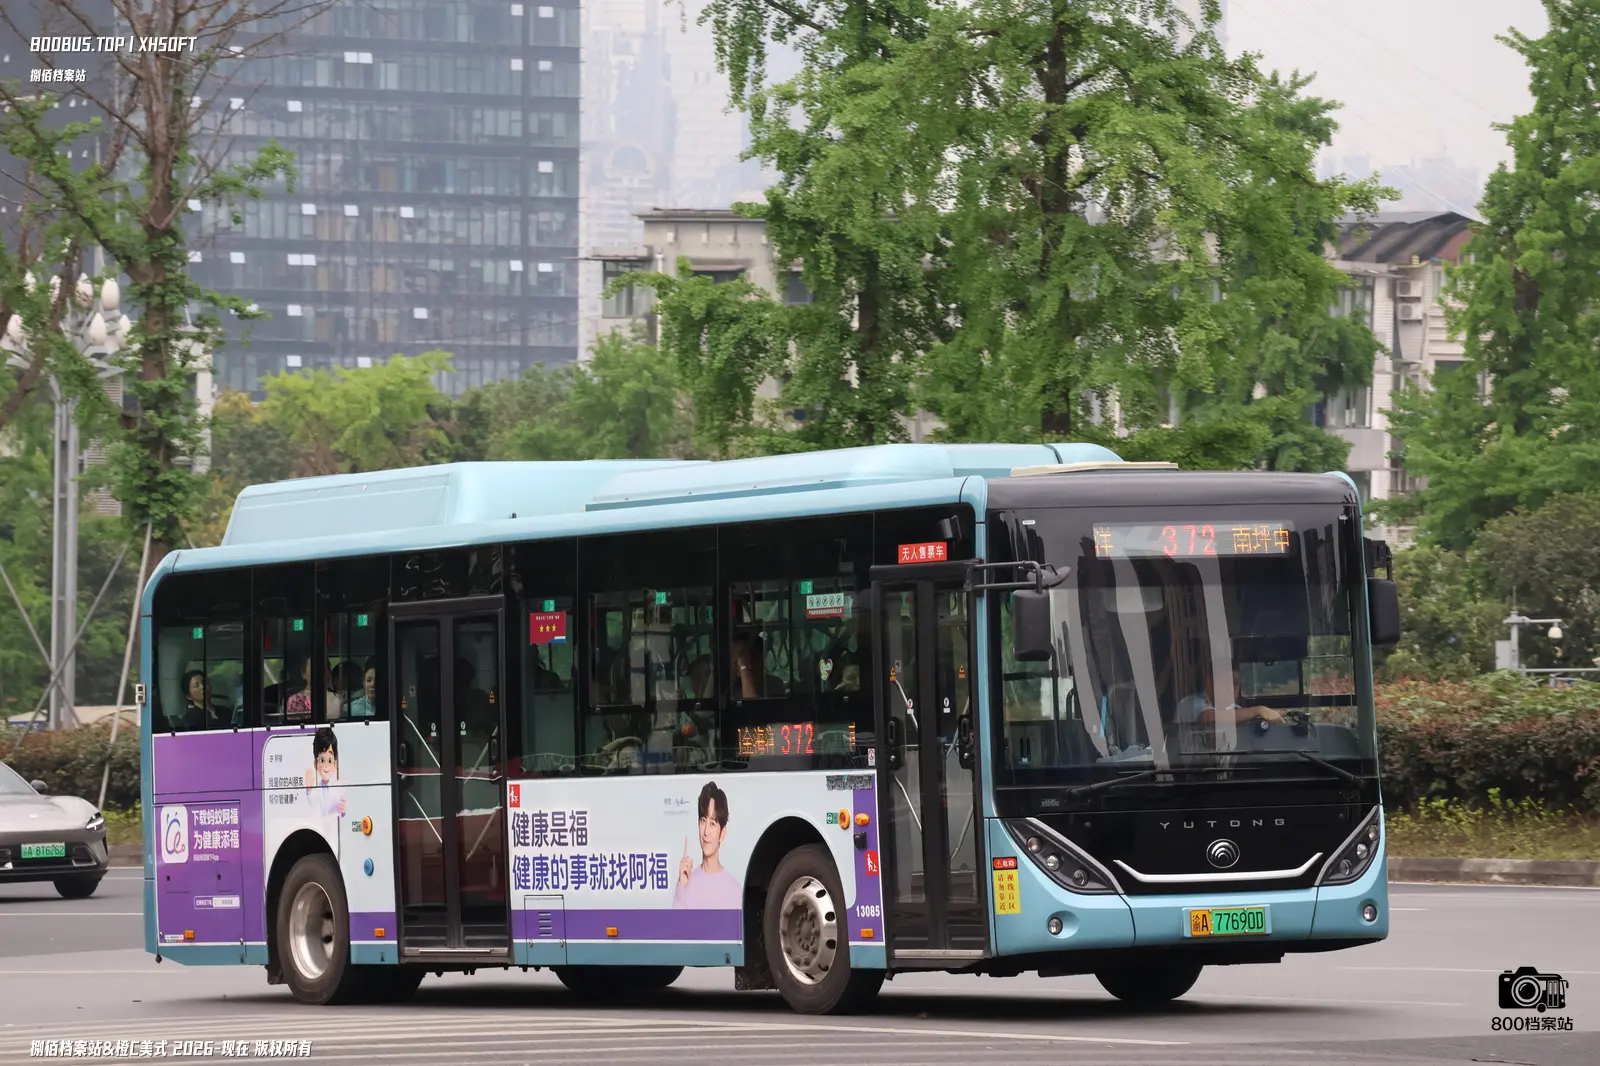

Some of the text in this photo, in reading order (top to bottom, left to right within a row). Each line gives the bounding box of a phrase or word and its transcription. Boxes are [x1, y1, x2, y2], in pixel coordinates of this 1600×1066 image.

[1161, 525, 1216, 557] 372
[1231, 524, 1289, 554] 南坪中
[902, 545, 944, 561] 无人售票车
[781, 723, 815, 755] 372
[192, 808, 239, 826] 下载蚂蚁阿福
[1159, 818, 1285, 830] YUTONG
[511, 809, 588, 848] 健康是福
[193, 829, 240, 850] 为健康添福
[512, 852, 669, 891] 健康的事就找阿福
[856, 905, 880, 918] 13085
